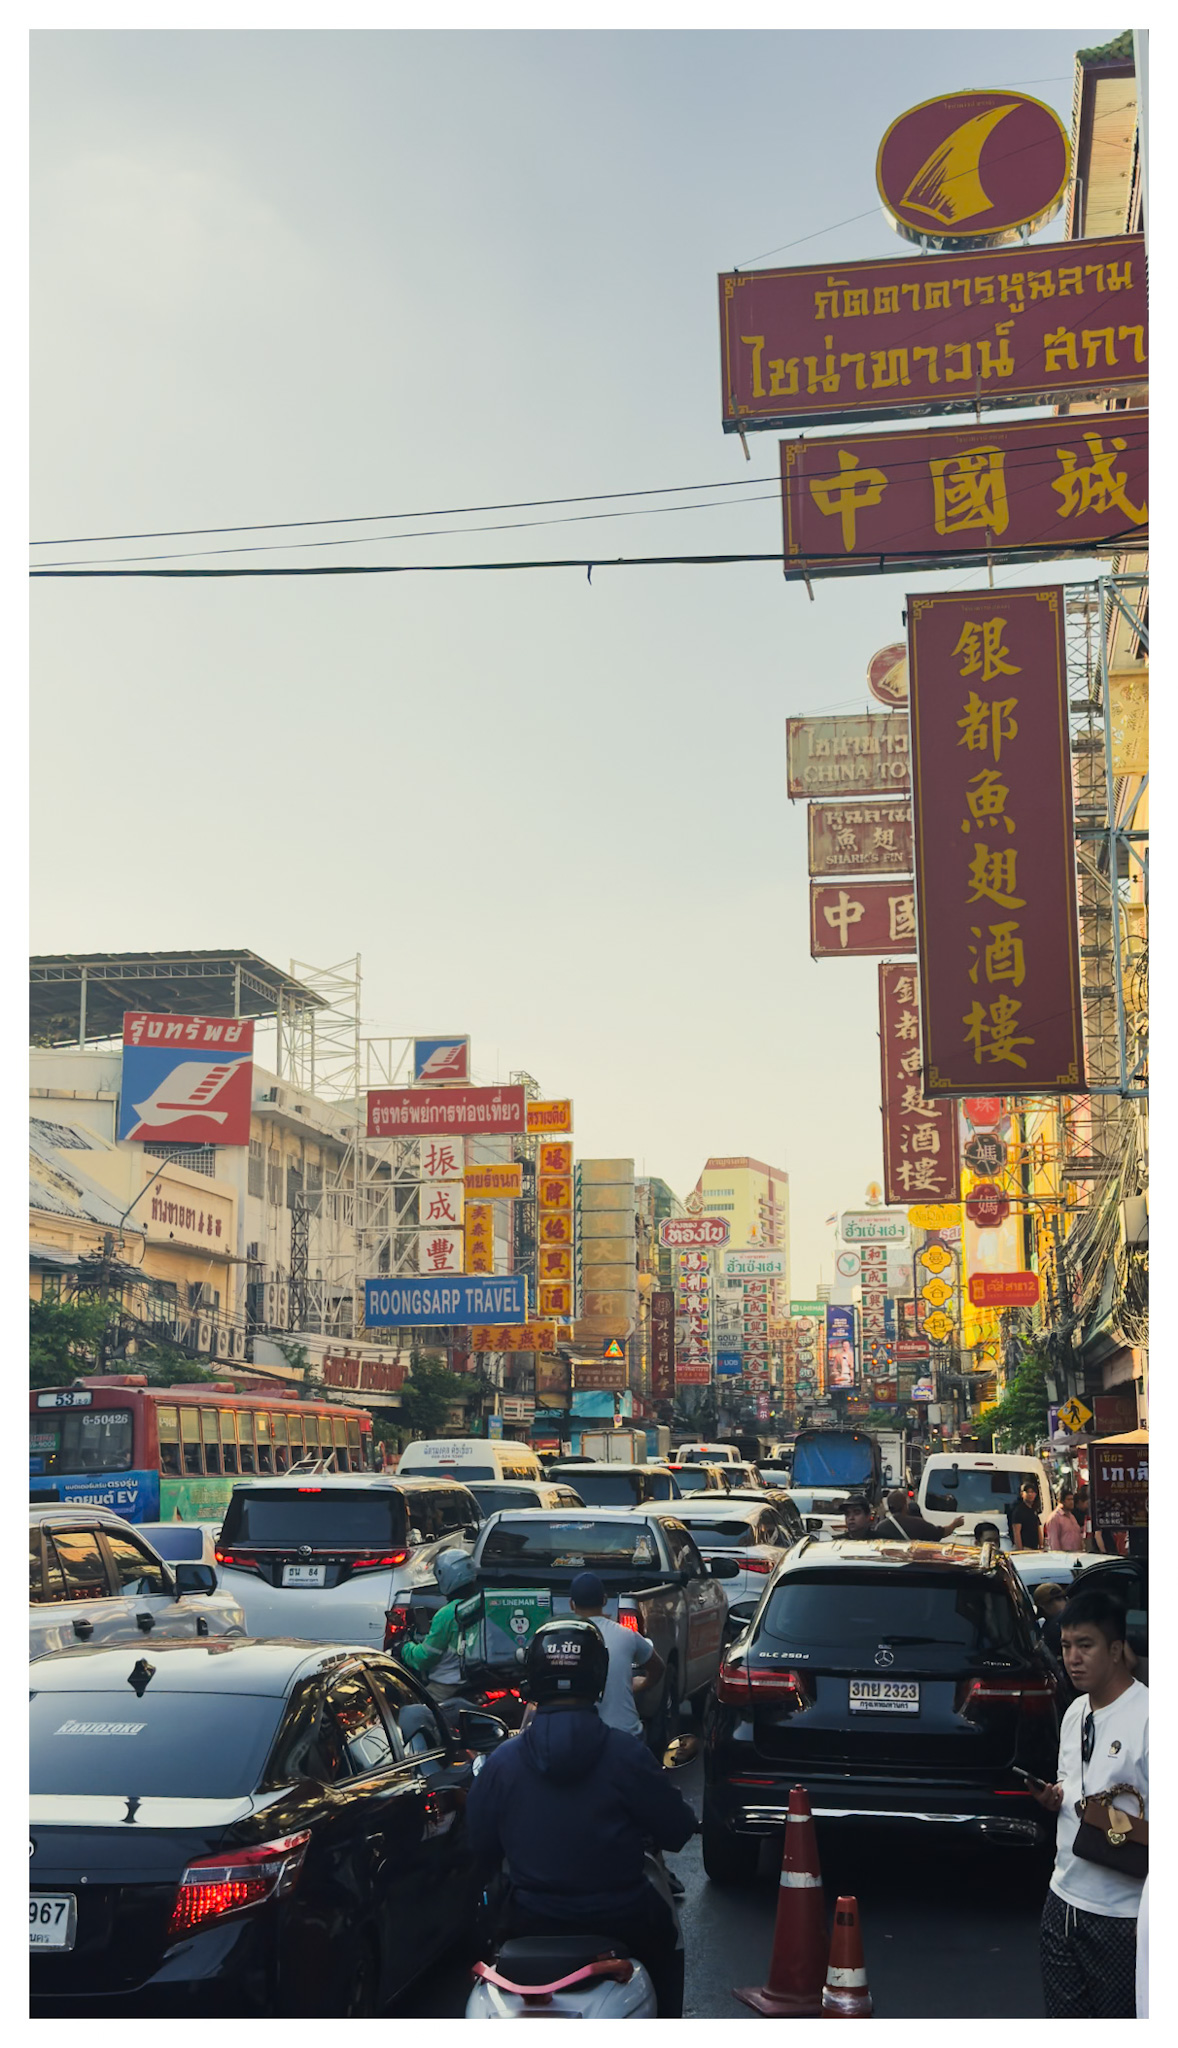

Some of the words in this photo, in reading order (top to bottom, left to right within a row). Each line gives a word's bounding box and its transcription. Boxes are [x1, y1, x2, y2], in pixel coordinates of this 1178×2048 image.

[741, 319, 1015, 398] ไชน่าทาวน์
[809, 432, 1148, 552] 中國城
[803, 764, 871, 783] CHINA
[877, 762, 911, 780] TO
[950, 616, 1034, 1069] 銀都魚翅酒樓
[826, 852, 879, 865] SHARK'S
[883, 852, 904, 863] FIN
[130, 1016, 248, 1045] รุ่งทรัพย์
[372, 1089, 520, 1134] รุ่งทรัพย์การท่องเที่ยว
[424, 1144, 459, 1272] 振成豐
[667, 1221, 724, 1243] ทองใบ
[370, 1289, 461, 1315] ROONGSARP
[465, 1287, 520, 1312] TRAVEL
[55, 1394, 75, 1406] 53
[82, 1414, 128, 1425] 6-50426
[117, 1490, 139, 1504] EV
[308, 1568, 318, 1576] 84
[502, 1599, 535, 1607] LINEMAN
[781, 1651, 810, 1659] 250d
[852, 1682, 880, 1698] 3กย
[883, 1683, 917, 1699] 2323
[29, 1902, 66, 1925] 967
